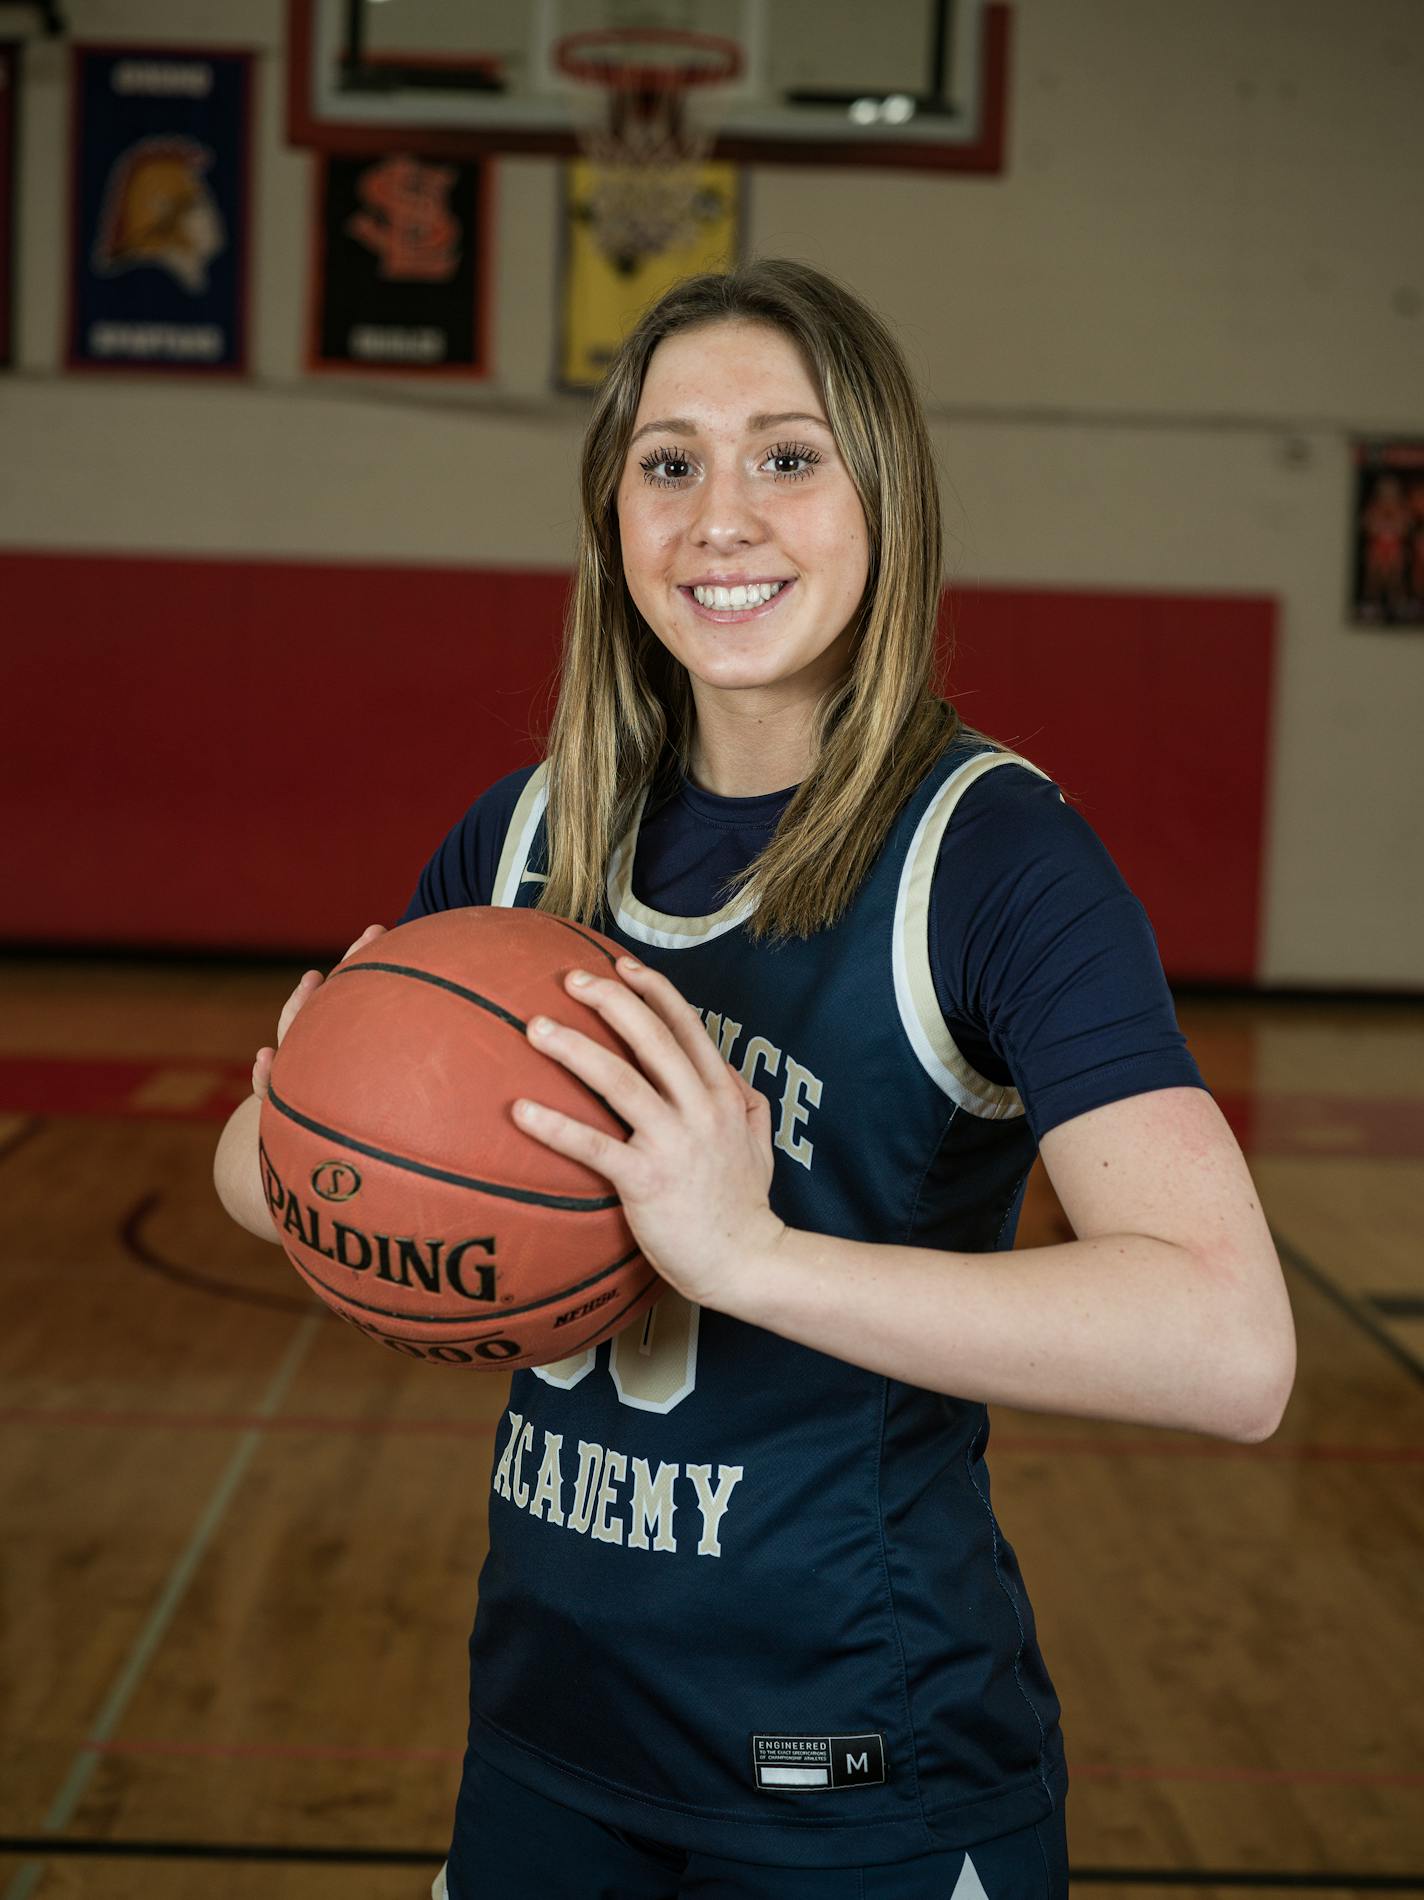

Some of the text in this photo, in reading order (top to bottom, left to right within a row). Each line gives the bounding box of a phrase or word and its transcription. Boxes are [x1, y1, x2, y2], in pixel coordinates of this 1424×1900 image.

[259, 1137, 497, 1303] PALDING
[493, 1410, 744, 1557] ACADEMY
[758, 1741, 827, 1750] ENGINEERED
[846, 1752, 869, 1775] M
